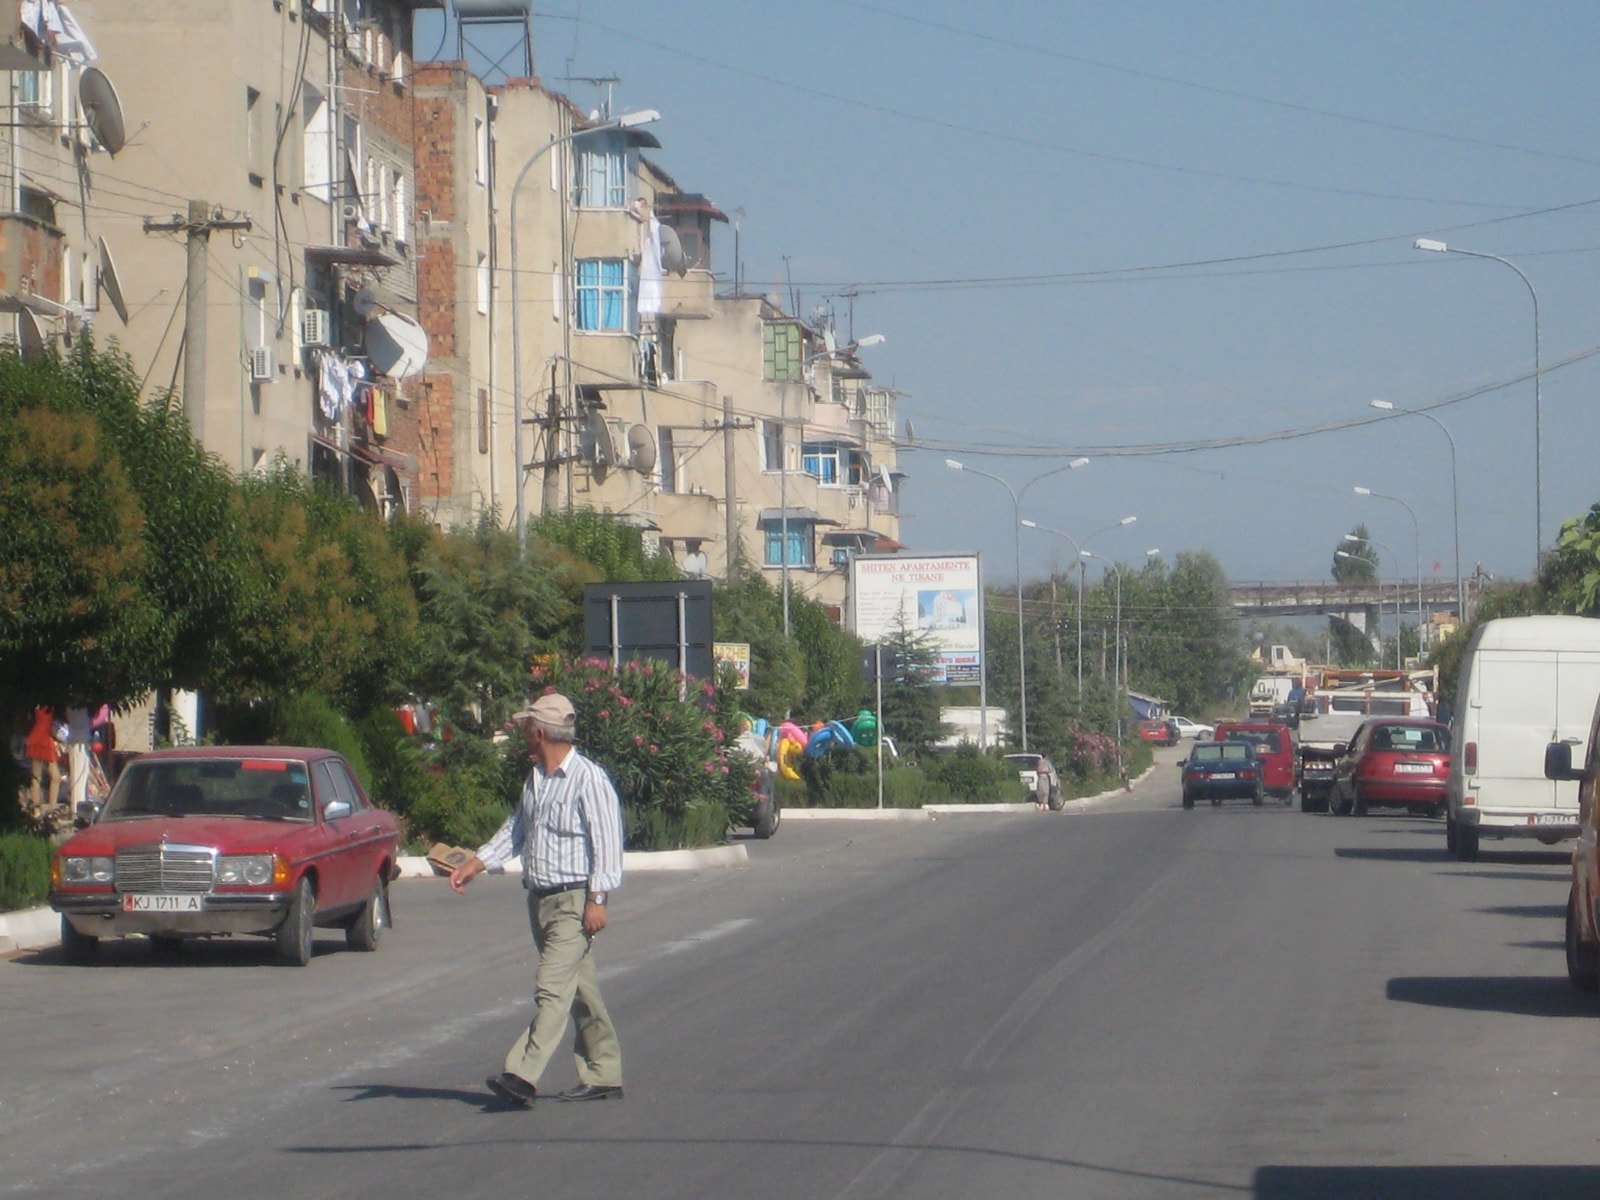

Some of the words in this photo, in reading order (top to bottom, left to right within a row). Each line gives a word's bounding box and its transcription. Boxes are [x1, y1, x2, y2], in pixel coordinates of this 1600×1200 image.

[861, 563, 896, 572] SHITEN
[900, 561, 970, 571] APARTAMENTE
[909, 573, 945, 582] TIRANE
[134, 897, 150, 909] KJ
[155, 897, 178, 909] 1711
[188, 897, 198, 909] A
